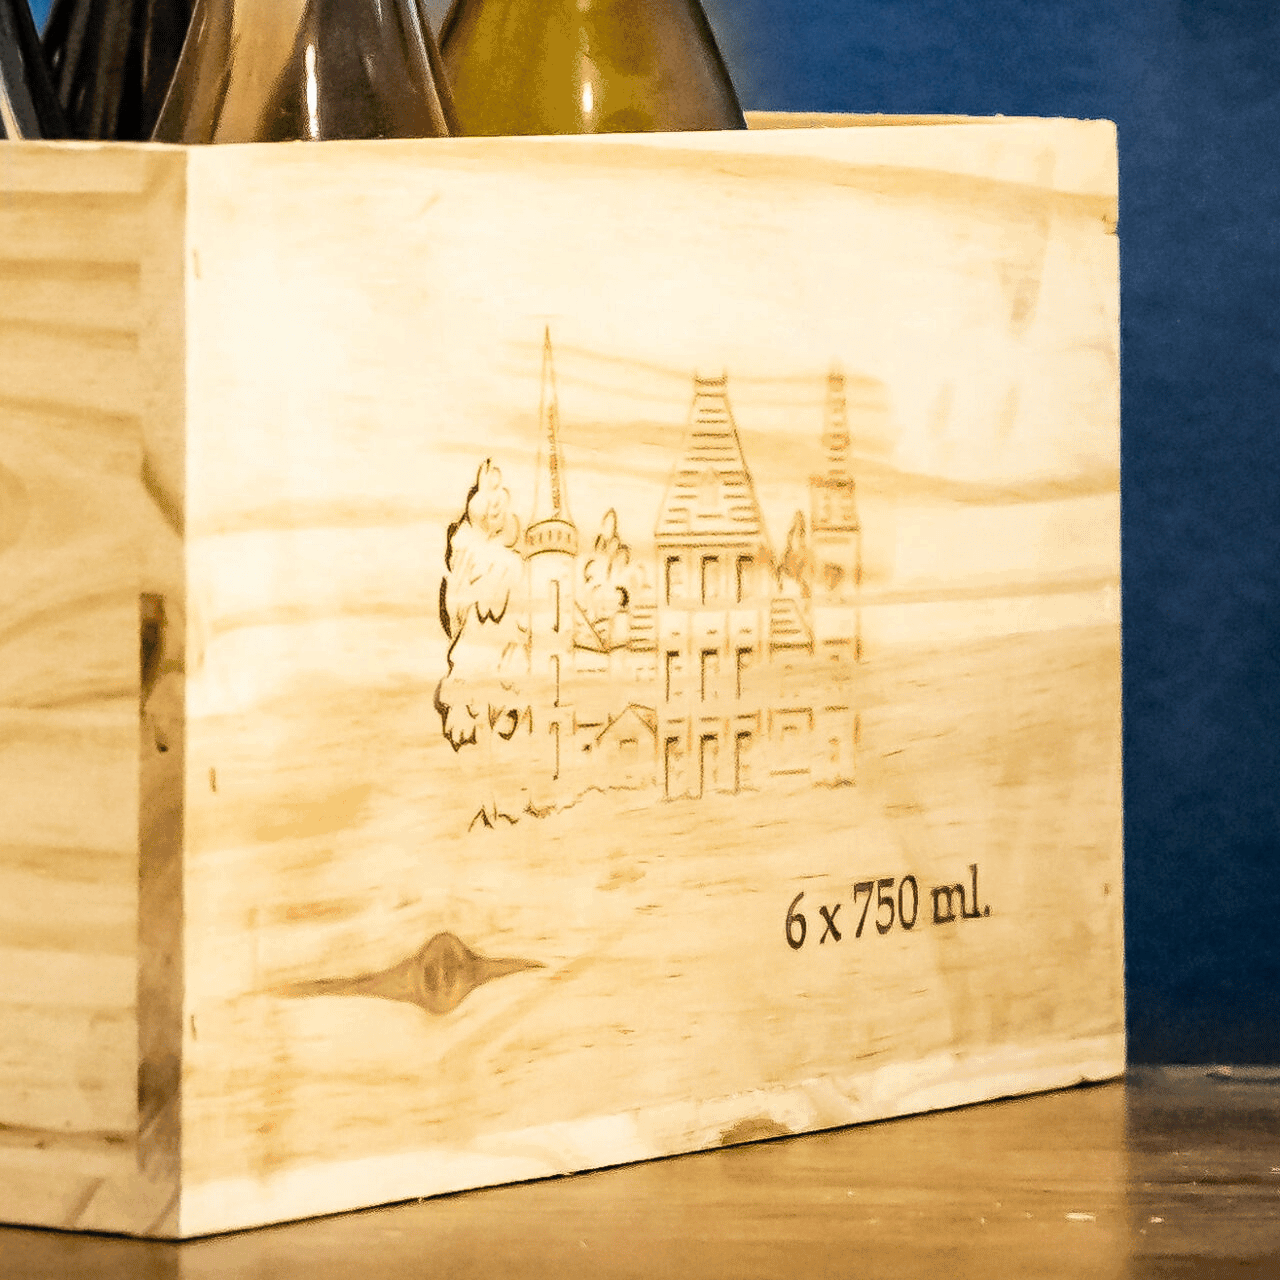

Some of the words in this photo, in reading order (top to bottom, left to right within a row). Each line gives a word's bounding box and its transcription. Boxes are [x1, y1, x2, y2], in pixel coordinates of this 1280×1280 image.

[785, 891, 807, 950] 6
[819, 903, 842, 944] x
[853, 875, 919, 938] 750
[930, 863, 991, 926] ml.
